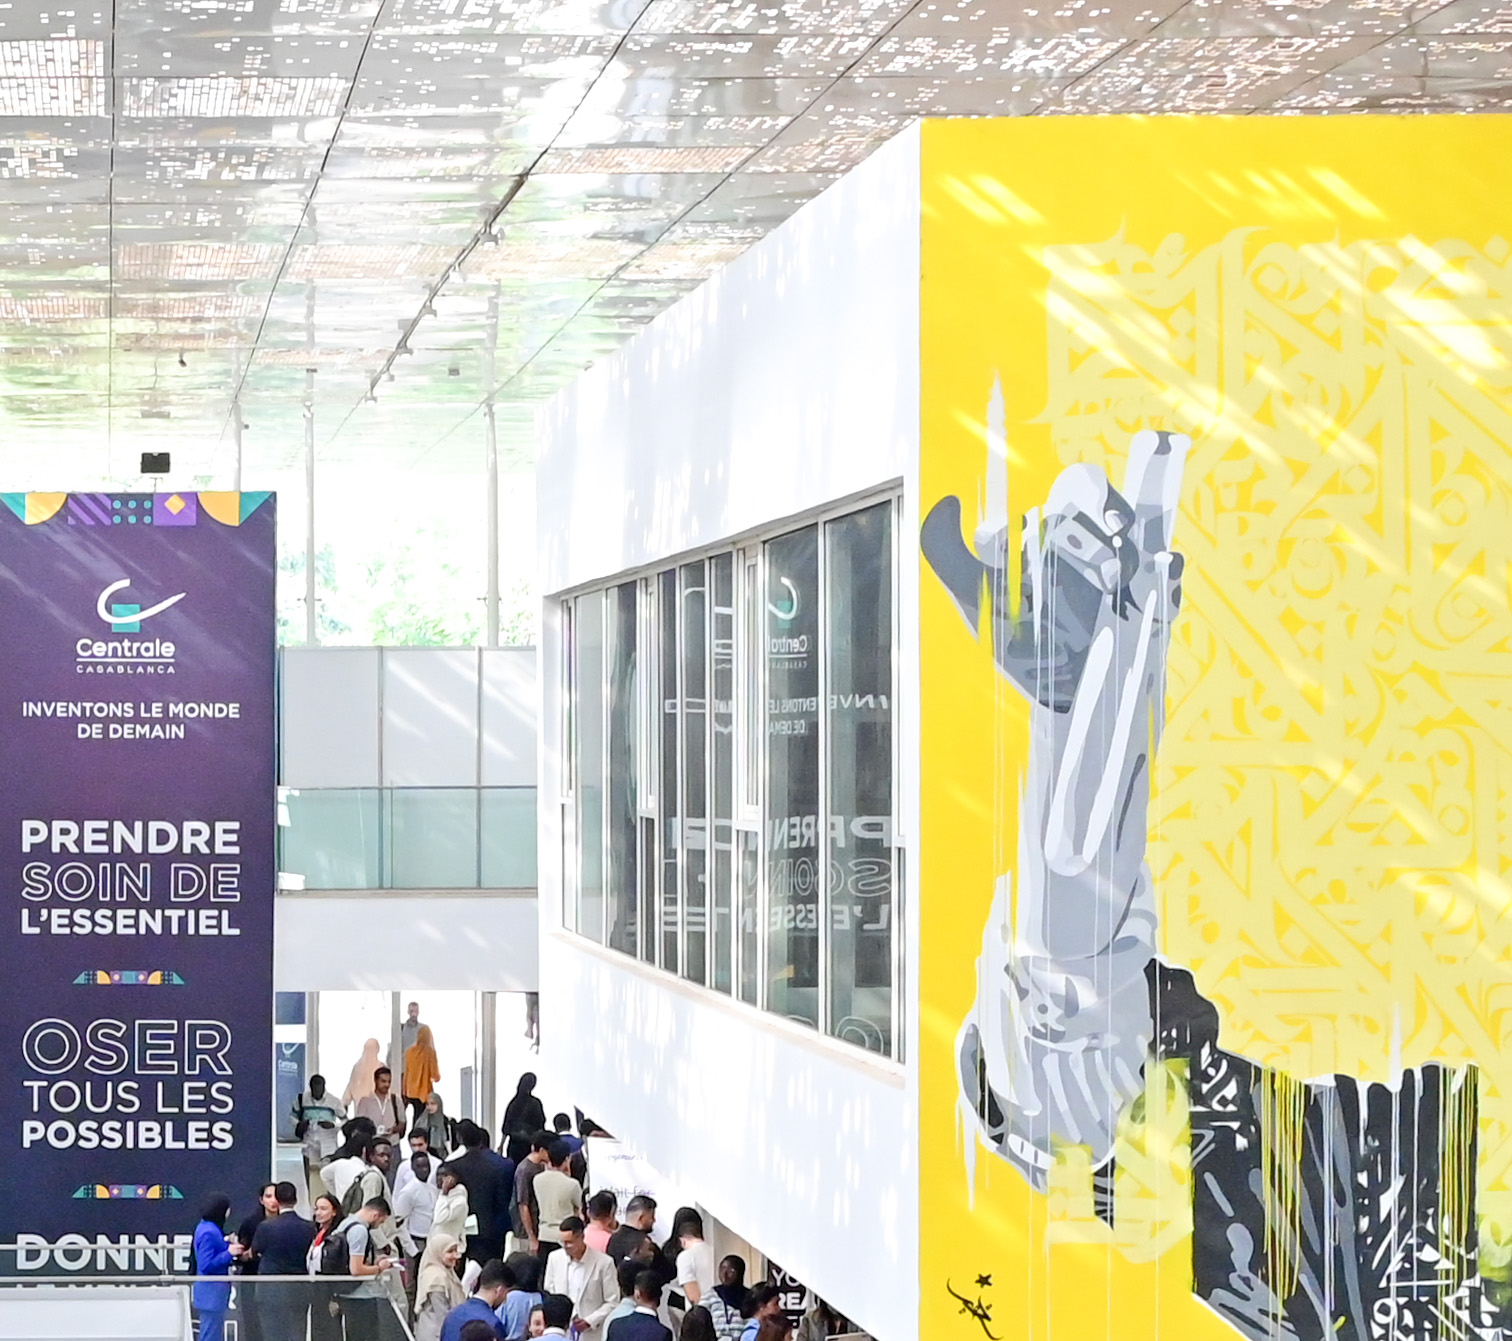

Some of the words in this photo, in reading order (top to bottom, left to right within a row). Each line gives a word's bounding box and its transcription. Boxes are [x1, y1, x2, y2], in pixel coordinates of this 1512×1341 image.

[76, 638, 175, 657] Centrale
[76, 664, 175, 674] CASABLANCA
[22, 701, 134, 718] INVENTONS
[140, 702, 166, 718] LE
[174, 702, 240, 718] MONDE
[77, 723, 105, 739] DE
[110, 723, 185, 739] DEMAIN
[22, 820, 240, 854] PRENDRE
[21, 862, 150, 901] SOIN
[170, 863, 240, 901] DE
[21, 909, 240, 935] L'ESSENTIEL
[22, 1017, 232, 1075] OSER
[23, 1081, 140, 1113] TOUS
[157, 1081, 234, 1113] LES
[22, 1120, 234, 1149] POSSIBLES
[16, 1233, 195, 1270] DONNE
